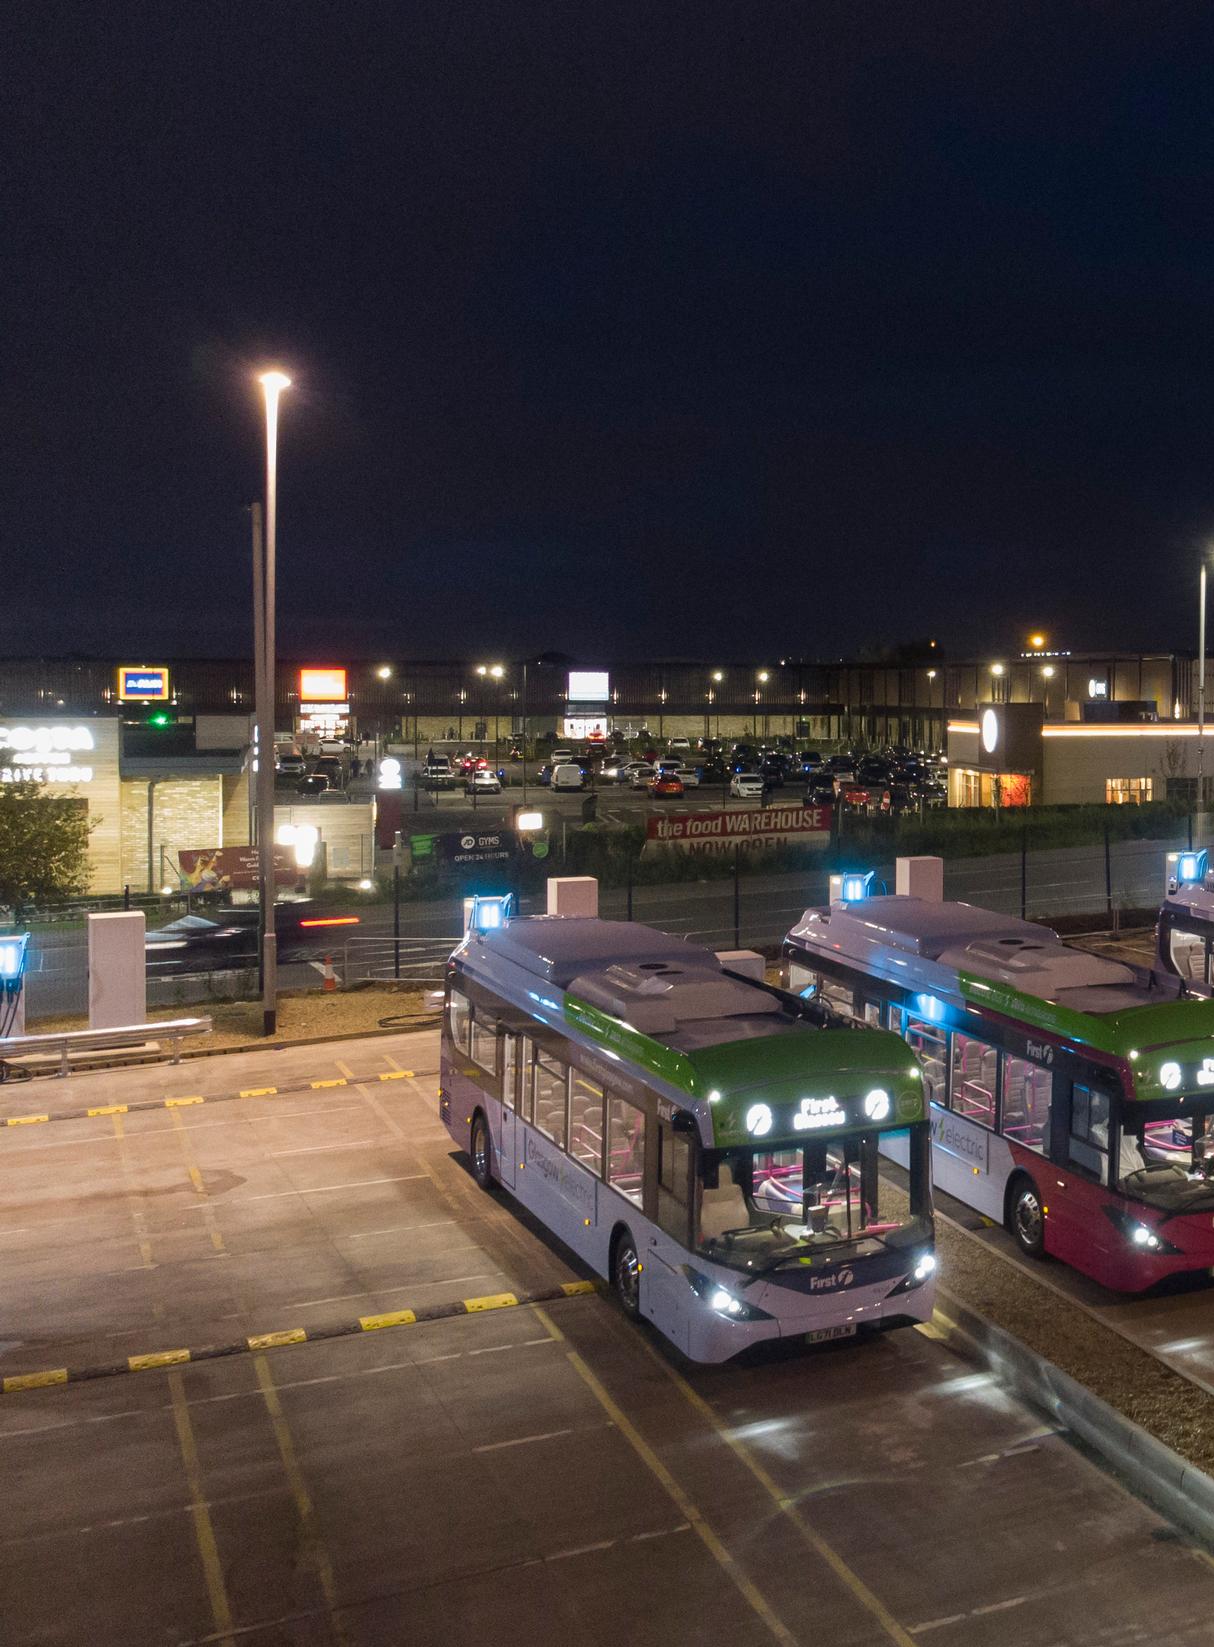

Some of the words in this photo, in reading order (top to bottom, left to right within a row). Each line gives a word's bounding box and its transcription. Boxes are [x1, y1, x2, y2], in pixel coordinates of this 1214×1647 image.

[657, 819, 683, 838] the
[686, 816, 723, 836] food
[726, 809, 823, 833] WAREHOUSE
[478, 836, 500, 846] GYMS
[454, 853, 474, 862] OPEN
[485, 852, 509, 860] HOURS
[1026, 1039, 1043, 1060] First
[945, 1125, 984, 1161] electric
[527, 1139, 559, 1182] Glasgow
[810, 1273, 837, 1290] First
